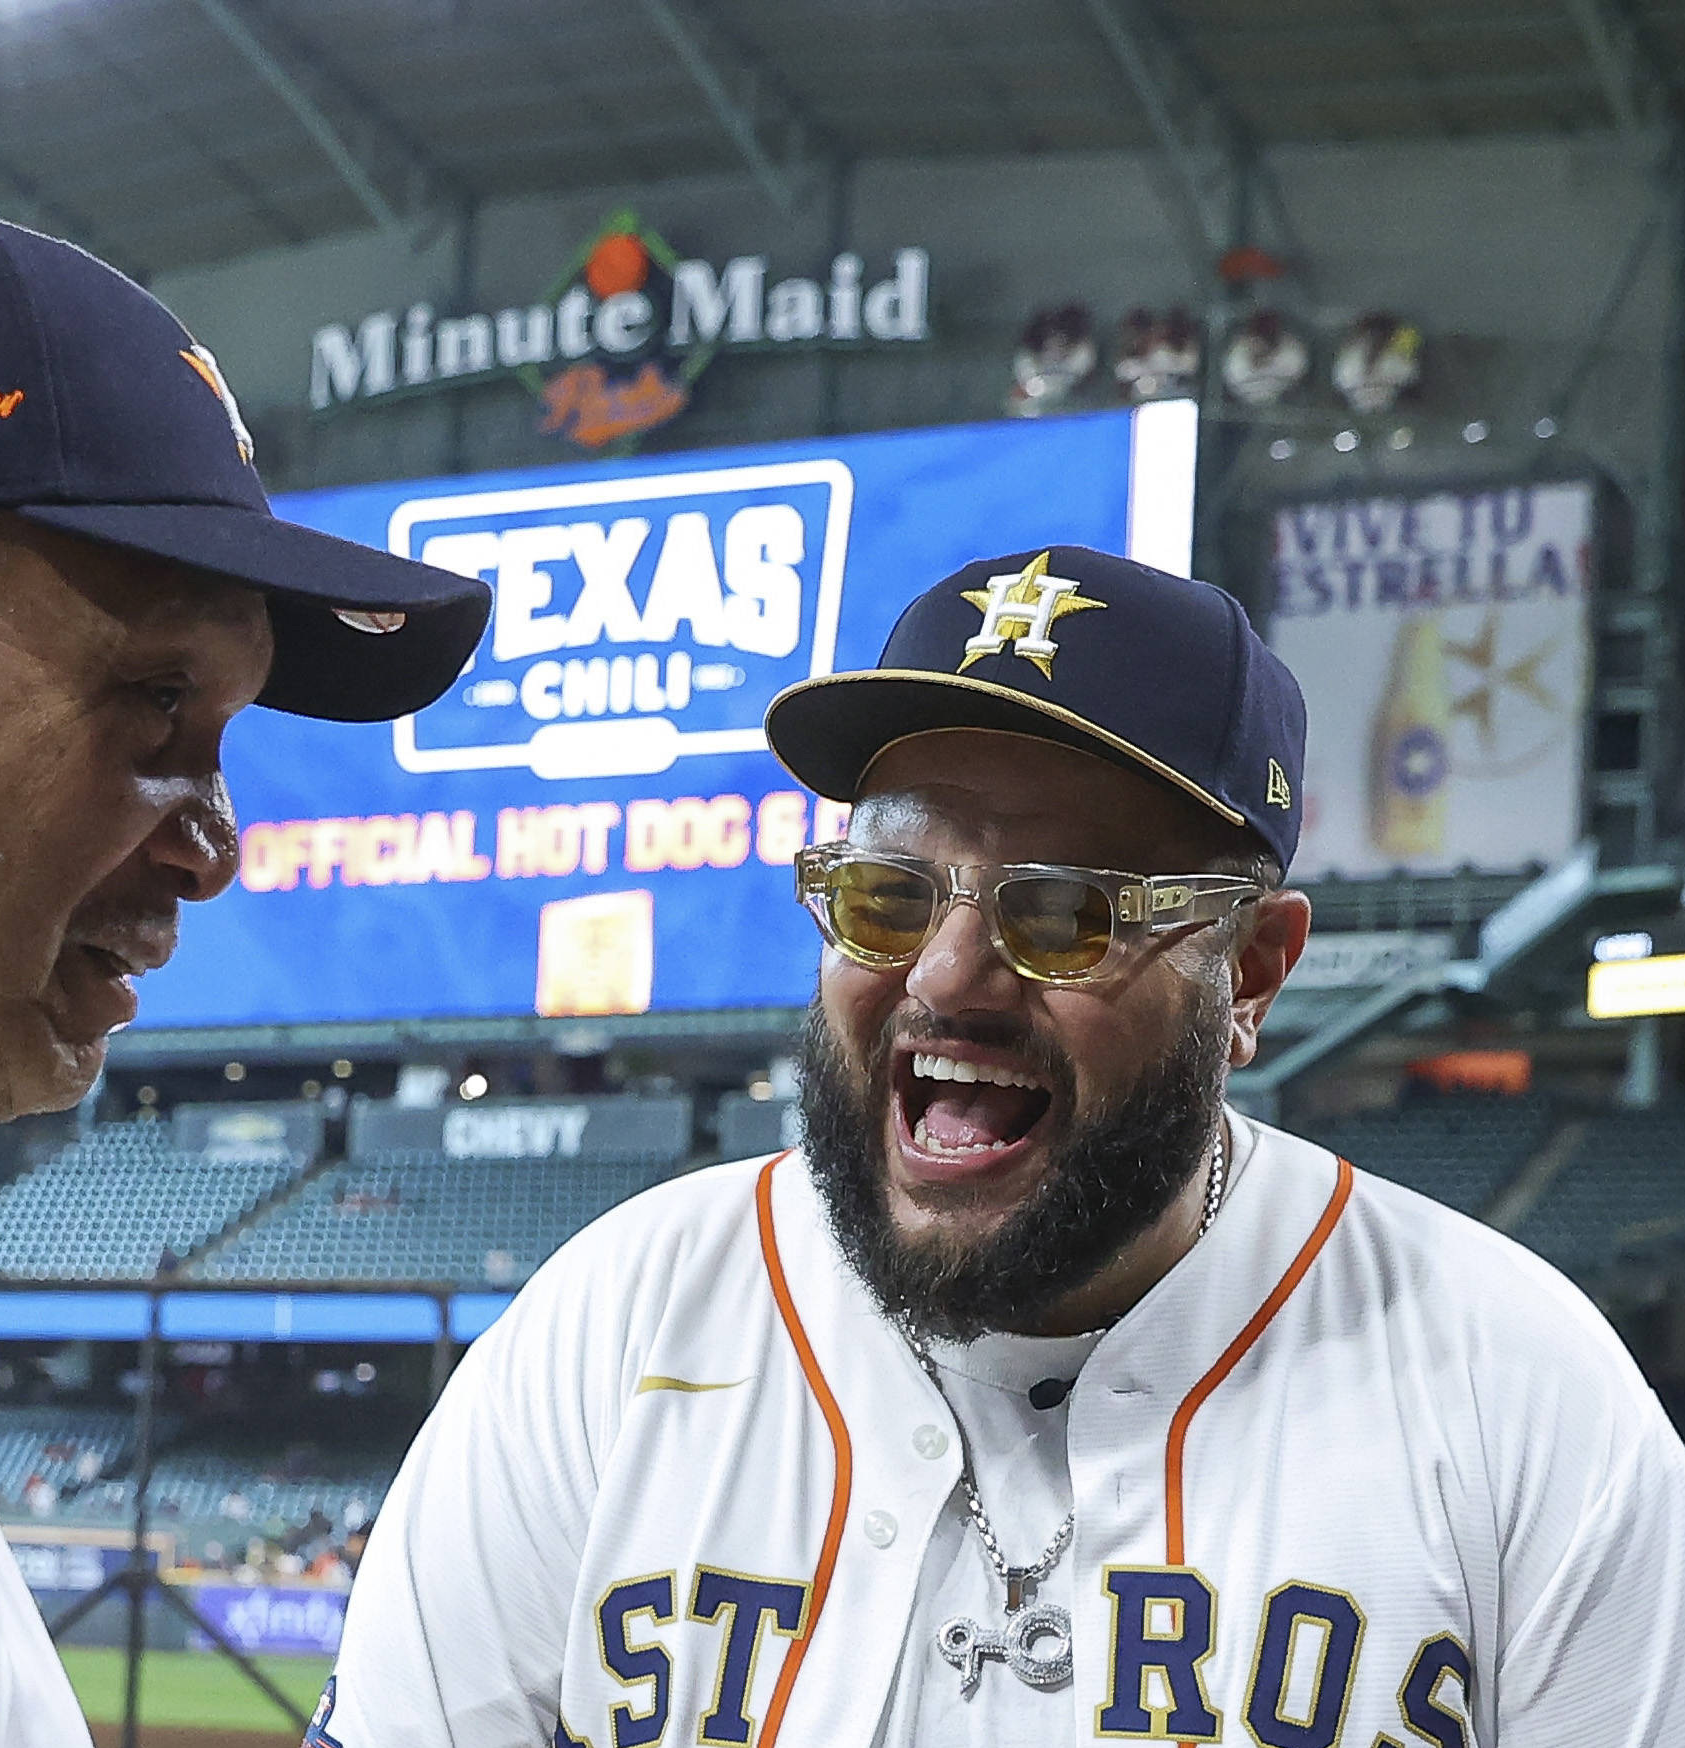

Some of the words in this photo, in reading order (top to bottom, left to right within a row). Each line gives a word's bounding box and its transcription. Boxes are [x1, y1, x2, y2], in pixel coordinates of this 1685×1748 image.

[310, 285, 654, 410] Minute
[669, 247, 930, 346] Maid
[1447, 488, 1535, 542] TU
[520, 652, 692, 720] CHILI
[240, 809, 492, 893] OFFICIAL
[494, 802, 622, 880] HOT
[623, 794, 753, 874] DOG
[442, 1104, 592, 1159] CHEVY
